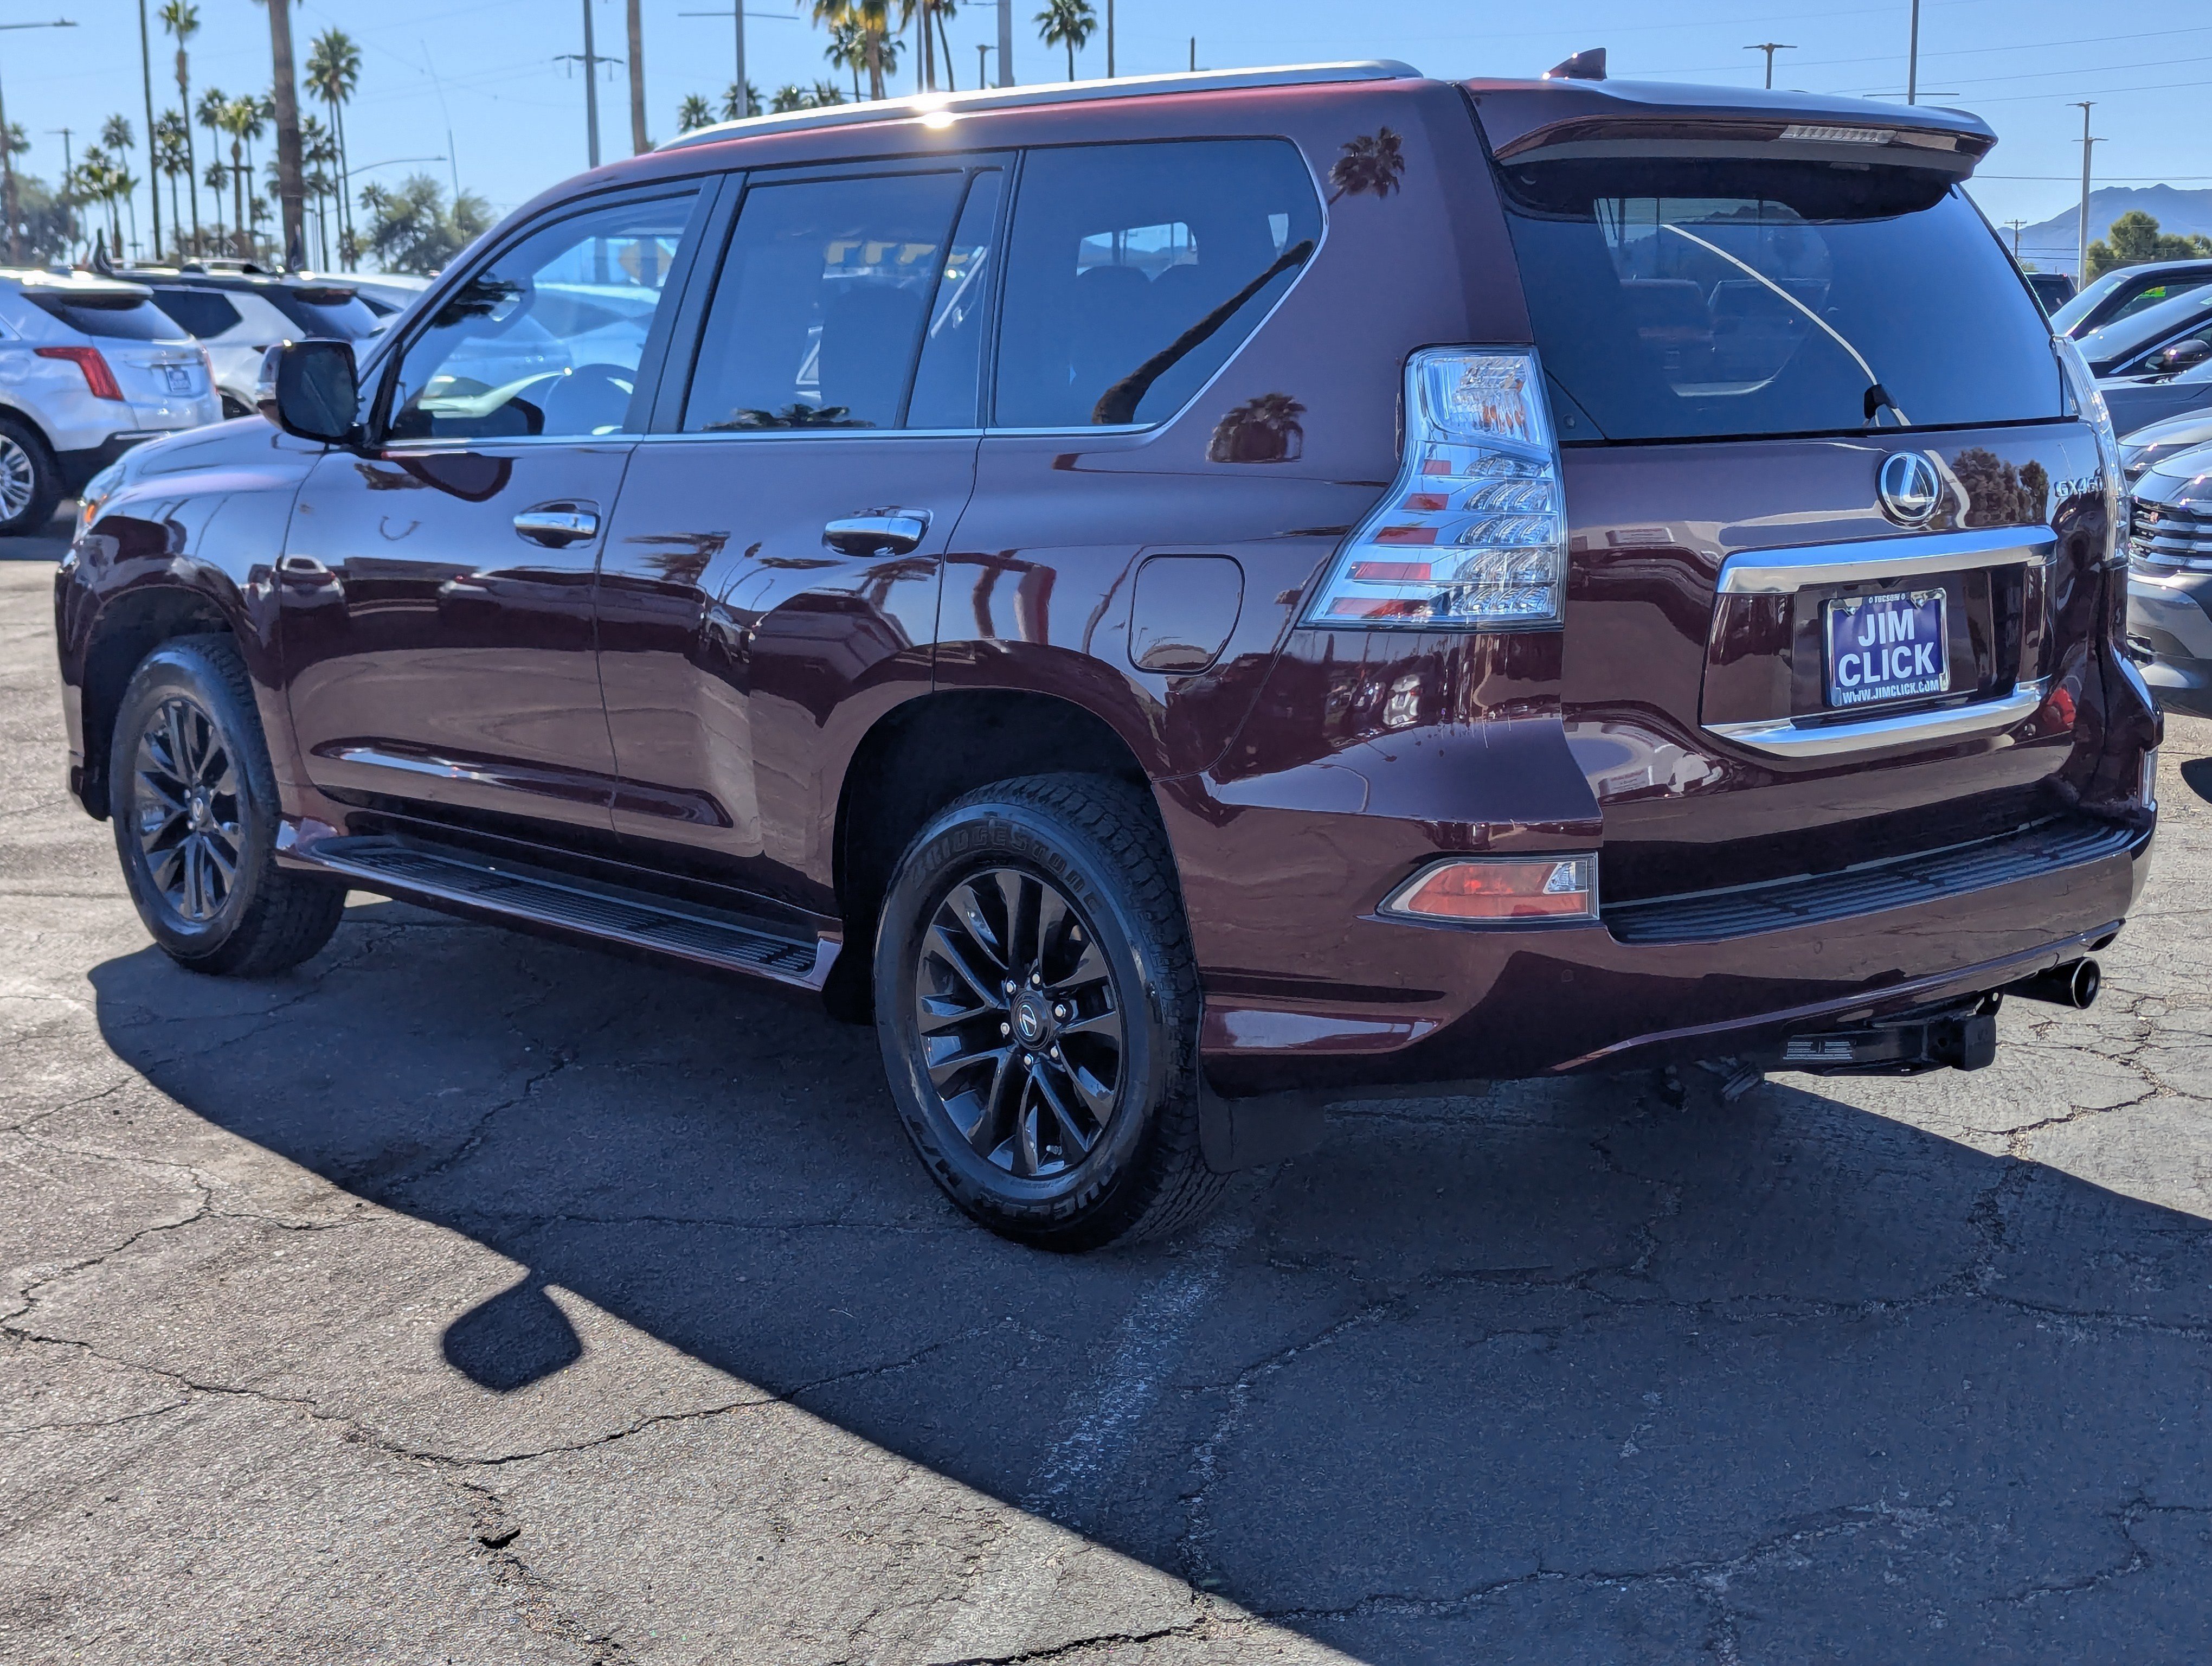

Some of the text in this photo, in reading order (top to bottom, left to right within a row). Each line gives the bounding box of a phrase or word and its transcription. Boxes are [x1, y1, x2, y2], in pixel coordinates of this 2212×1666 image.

[1858, 609, 1914, 646] JIM
[1838, 642, 1935, 687] CLICK
[1842, 680, 1939, 703] WWW.JIMCLICK.COM
